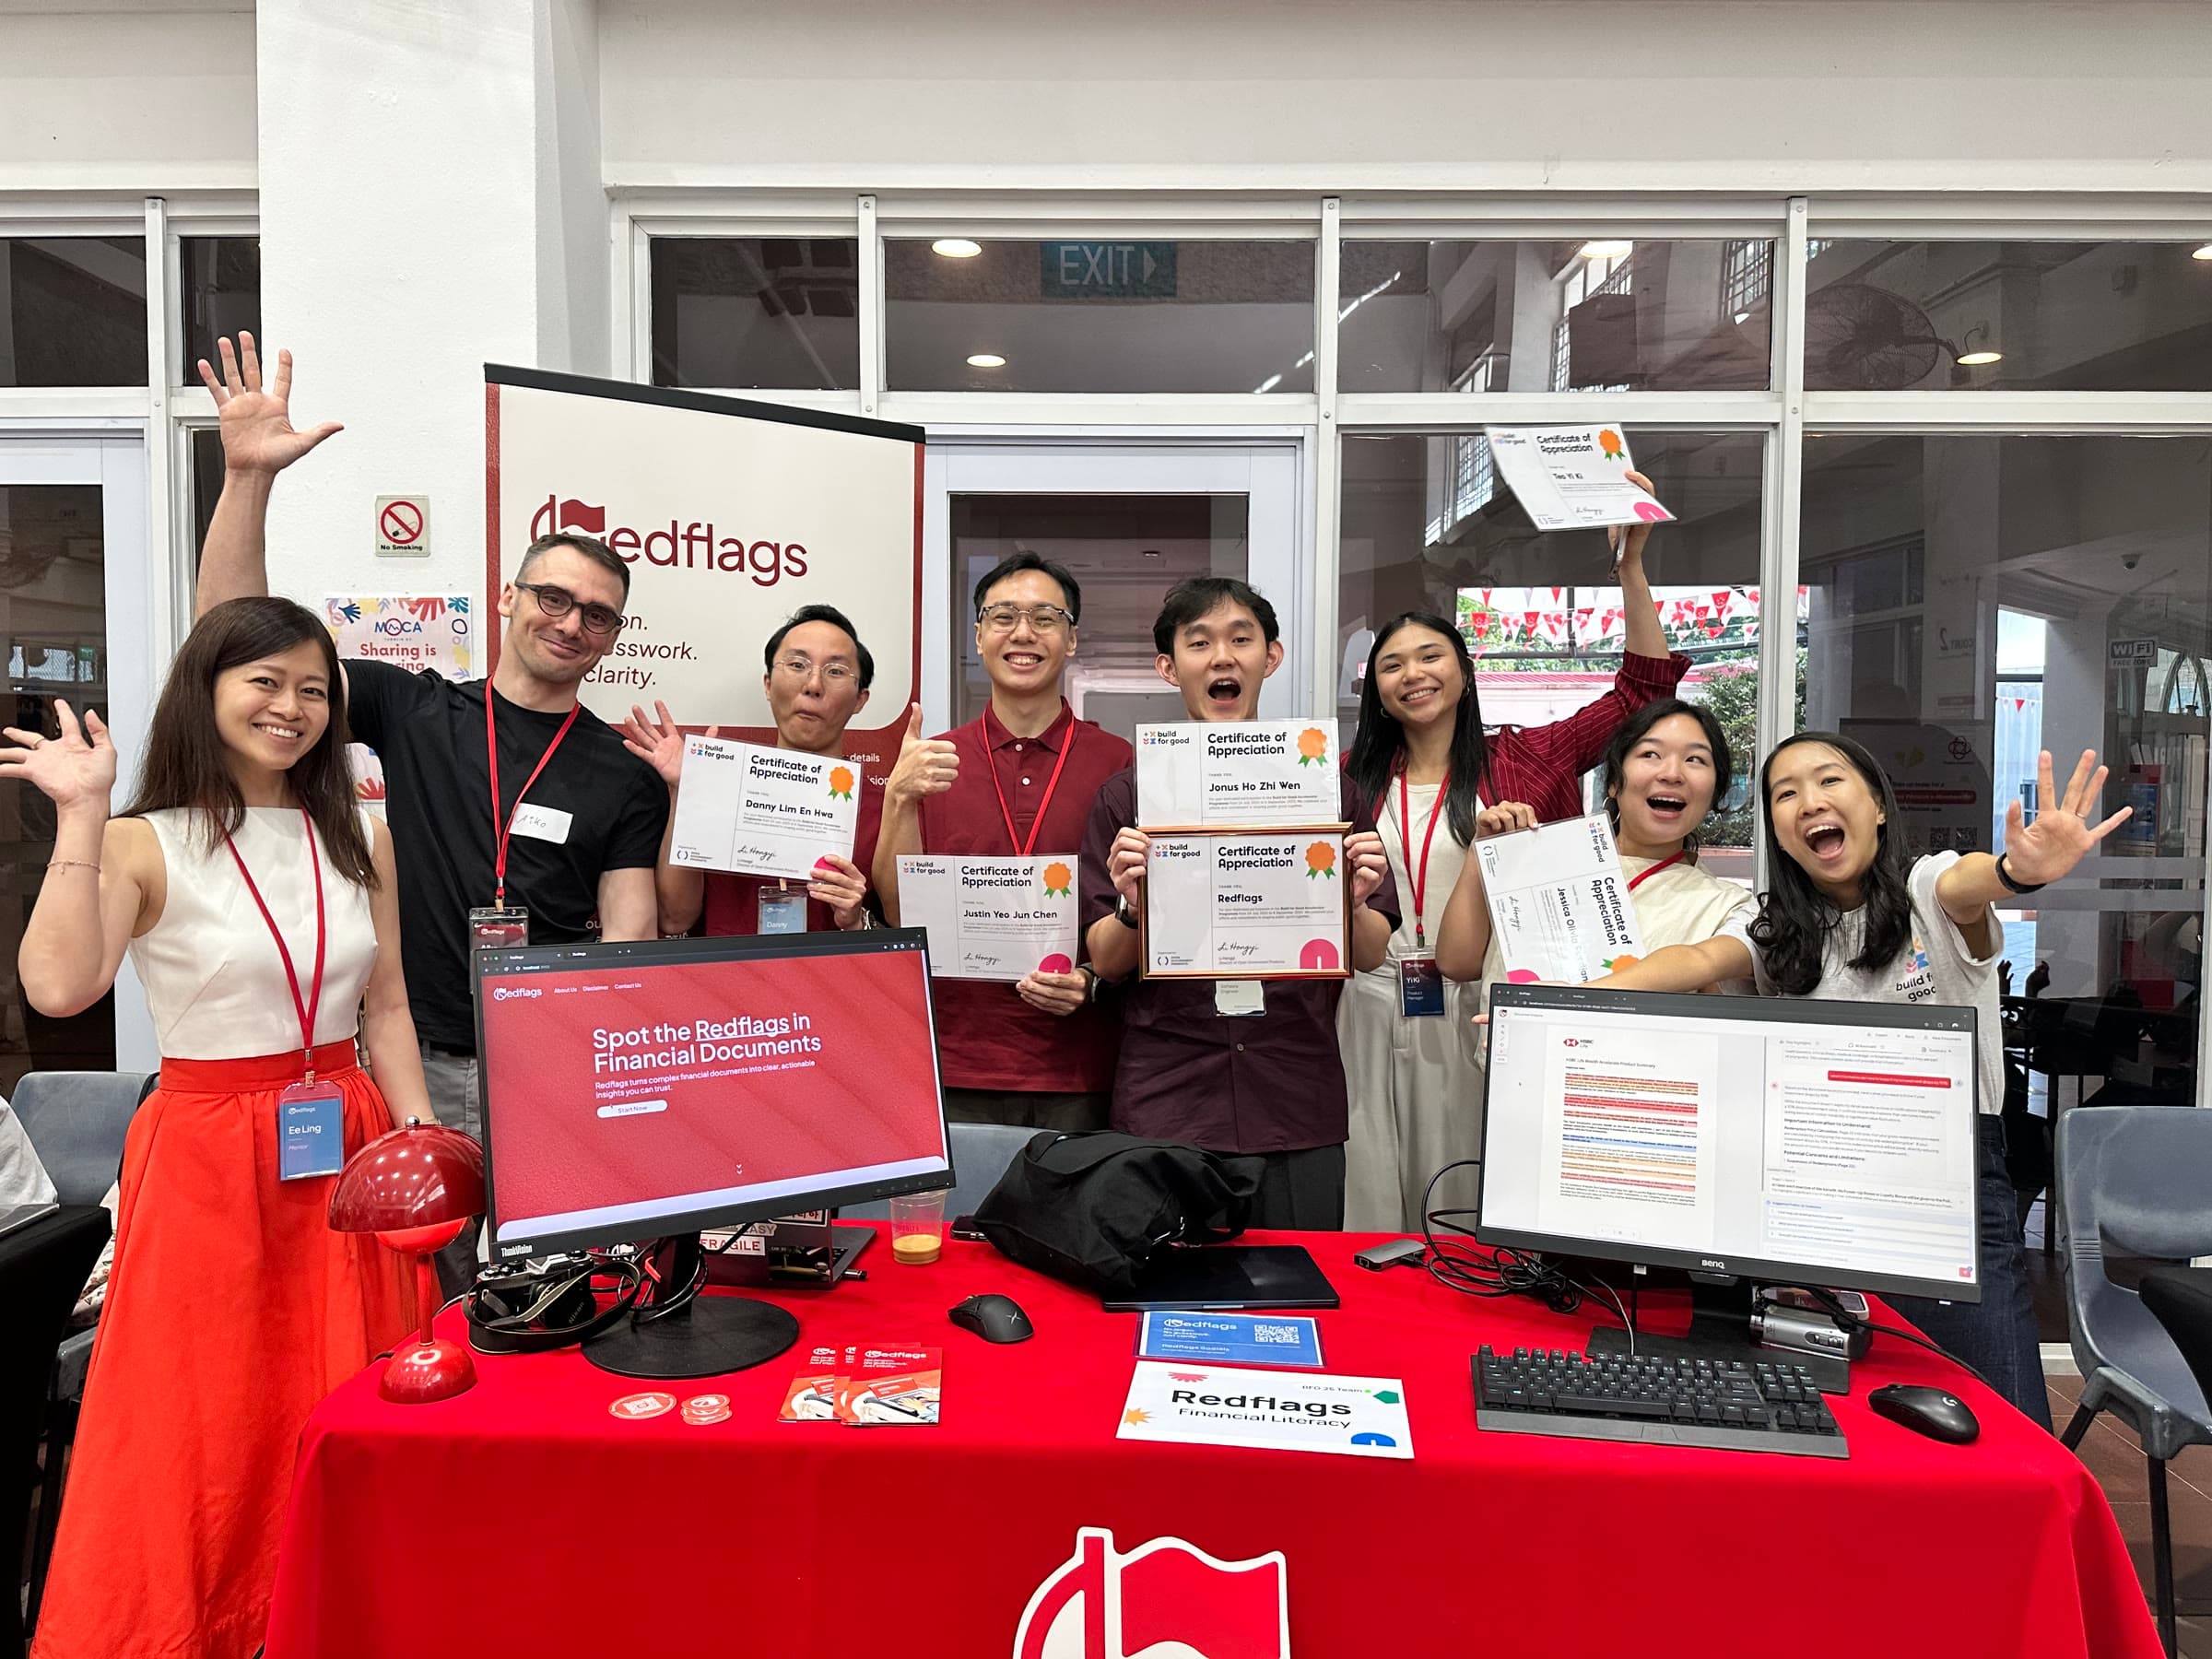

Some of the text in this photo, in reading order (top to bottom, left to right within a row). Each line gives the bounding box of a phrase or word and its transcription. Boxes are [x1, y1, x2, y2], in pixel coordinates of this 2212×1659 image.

[1060, 245, 1135, 285] EXIT
[1536, 433, 1591, 444] Certificate of
[1541, 444, 1594, 455] Appreciation
[360, 643, 436, 660] Sharing is
[584, 665, 656, 689] clarity.
[1171, 737, 1190, 746] good
[1207, 732, 1287, 744] Certificate of
[705, 744, 724, 752] build
[1208, 745, 1285, 759] Appreciation
[716, 753, 735, 761] good
[850, 753, 880, 762] details
[750, 755, 822, 773] Certificate of
[749, 766, 818, 785] Appreciation
[1209, 782, 1300, 792] Jonus Ho Zhi Wen
[746, 799, 833, 819] Danny Lim En Hwa
[1599, 833, 1608, 850] build
[1182, 850, 1201, 858] good
[1218, 845, 1296, 857] Certificate of
[1594, 845, 1605, 863] good
[1218, 857, 1293, 871] Appreciation
[961, 866, 1034, 876] Certificate of
[962, 877, 1031, 888] Appreciation
[1218, 893, 1263, 903] Redflags
[1557, 888, 1571, 917] Jessica
[963, 910, 991, 918] Justin
[994, 911, 1010, 919] Yeo
[1033, 911, 1058, 919] Chen
[1592, 879, 1617, 946] Appreciation
[1604, 877, 1632, 945] Certificate of
[1896, 974, 1924, 991] build
[593, 1012, 811, 1053] Spot the Redflags in
[594, 1035, 822, 1074] Financial Documents
[595, 1080, 629, 1089] Redflags
[629, 1077, 647, 1086] turns
[648, 1075, 680, 1085] complex
[680, 1070, 709, 1080] financial
[710, 1067, 749, 1077] documents
[781, 1060, 816, 1069] actionable
[626, 1088, 640, 1097] you
[288, 1124, 322, 1135] Ee Ling
[1701, 1259, 1725, 1269] BenQ
[1163, 1319, 1237, 1330] Redflags
[865, 1350, 927, 1359] Redflags
[1171, 1389, 1352, 1418] Redflags
[1179, 1407, 1351, 1429] Financial Literacy
